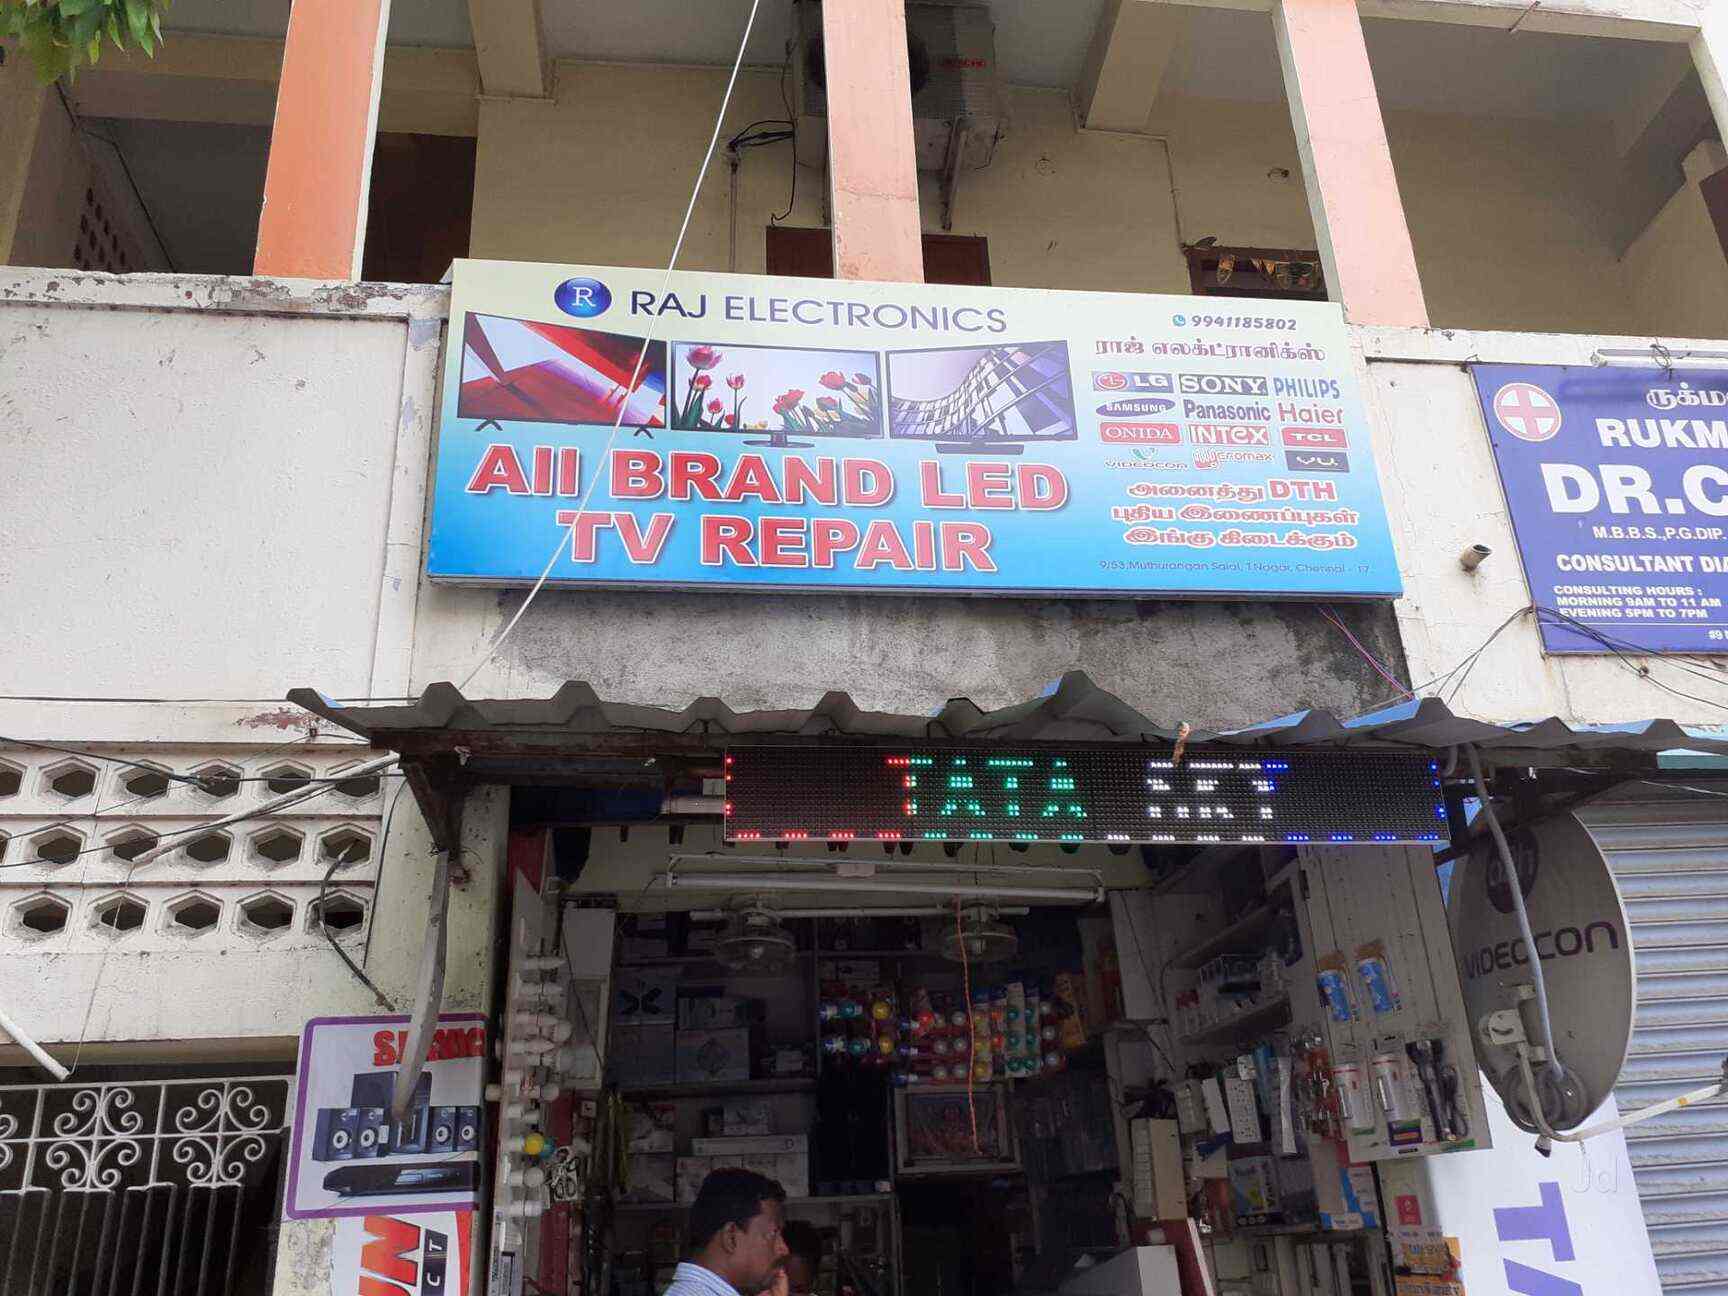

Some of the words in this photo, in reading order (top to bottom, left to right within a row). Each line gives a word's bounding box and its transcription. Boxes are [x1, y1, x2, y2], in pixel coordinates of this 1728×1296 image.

[631, 290, 707, 319] RAJ
[725, 295, 1008, 333] ELECTRONICS
[1190, 314, 1297, 331] 9941185802
[1095, 336, 1145, 355] ராஜ்
[1180, 376, 1268, 395] SONY
[1273, 377, 1341, 399] PHILIPS
[1106, 401, 1167, 413] SAMSUNG
[1183, 399, 1272, 422] Panasonic
[1278, 402, 1344, 424] Haier
[1105, 428, 1174, 440] ONIDA
[1291, 432, 1337, 442] TCL
[609, 449, 896, 507] BRAND
[919, 458, 1069, 511] LED
[1269, 480, 1337, 501] DTH
[556, 510, 676, 565] TV
[700, 514, 998, 572] REPAIR
[1556, 554, 1694, 573] CONSULTANT
[1553, 585, 1643, 596] CONSULTING
[1647, 586, 1695, 596] HOURS
[1557, 596, 1623, 607] MORNING
[1656, 597, 1677, 607] TO
[1701, 598, 1722, 607] AM
[1559, 608, 1622, 618] EVENING
[1625, 608, 1655, 618] 5PM
[1656, 608, 1677, 618] TO
[1679, 609, 1709, 618] 7PM
